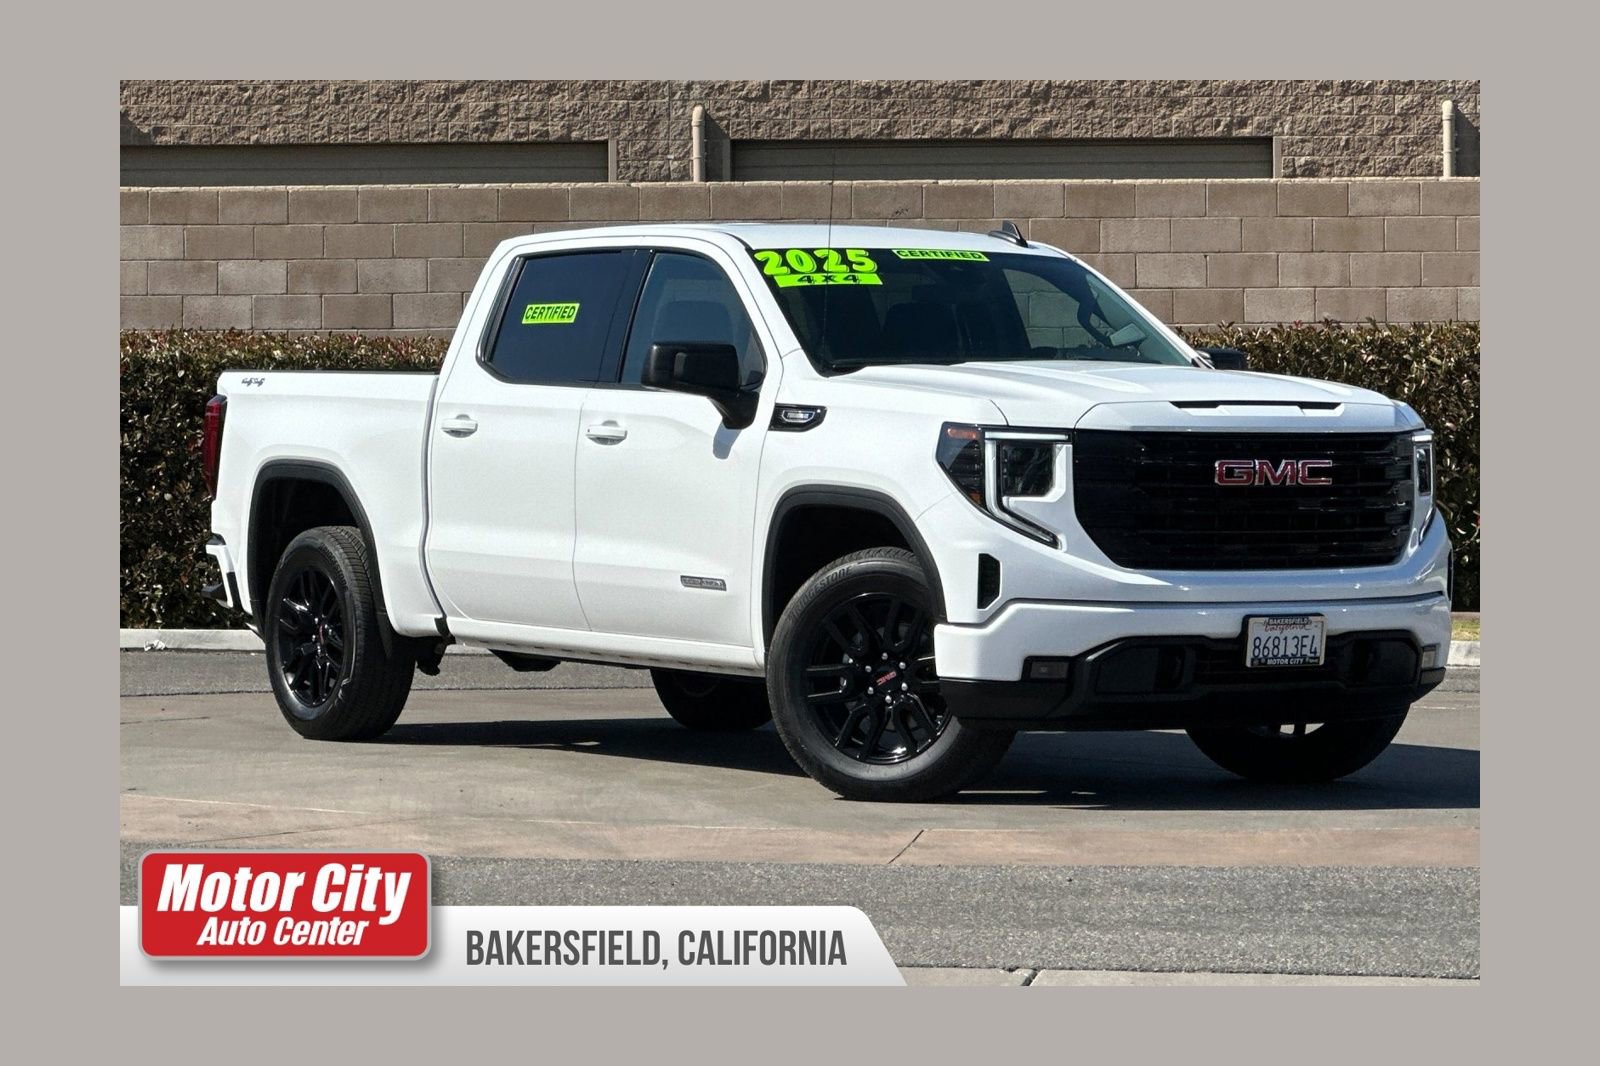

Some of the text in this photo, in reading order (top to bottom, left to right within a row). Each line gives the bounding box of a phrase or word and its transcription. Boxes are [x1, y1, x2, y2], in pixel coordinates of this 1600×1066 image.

[754, 248, 877, 275] 2025
[895, 250, 982, 259] CERTIFIED
[525, 305, 576, 320] CERTIFIED
[1215, 459, 1333, 486] GMC
[1269, 617, 1309, 625] BAKERSFIELD
[1253, 635, 1318, 658] 86813E4
[1290, 657, 1304, 665] CITY
